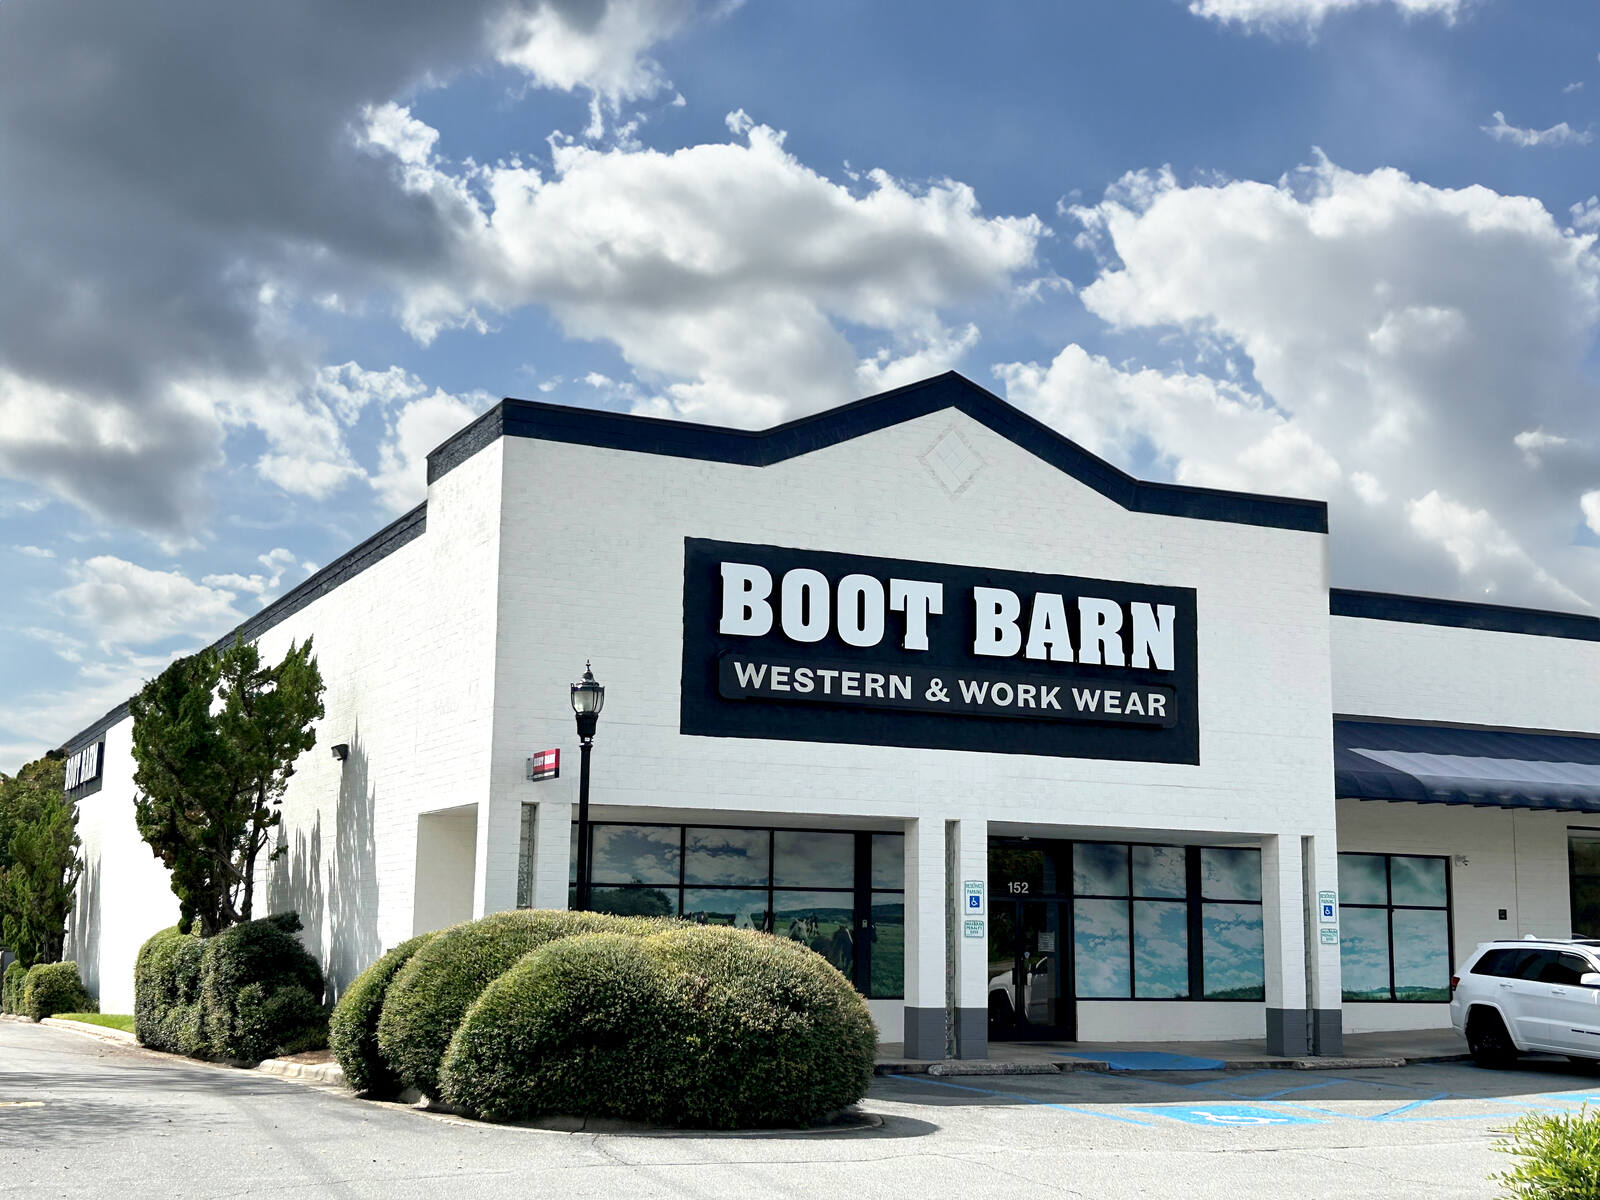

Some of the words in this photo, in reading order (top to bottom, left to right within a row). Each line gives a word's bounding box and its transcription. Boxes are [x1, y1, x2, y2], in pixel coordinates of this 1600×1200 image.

[719, 561, 944, 651] BOOT
[973, 586, 1176, 671] BARN
[733, 661, 912, 700] WESTERN
[925, 678, 951, 703] &
[957, 679, 1062, 710] WORK
[1071, 687, 1167, 717] WEAR
[1007, 881, 1029, 894] 152
